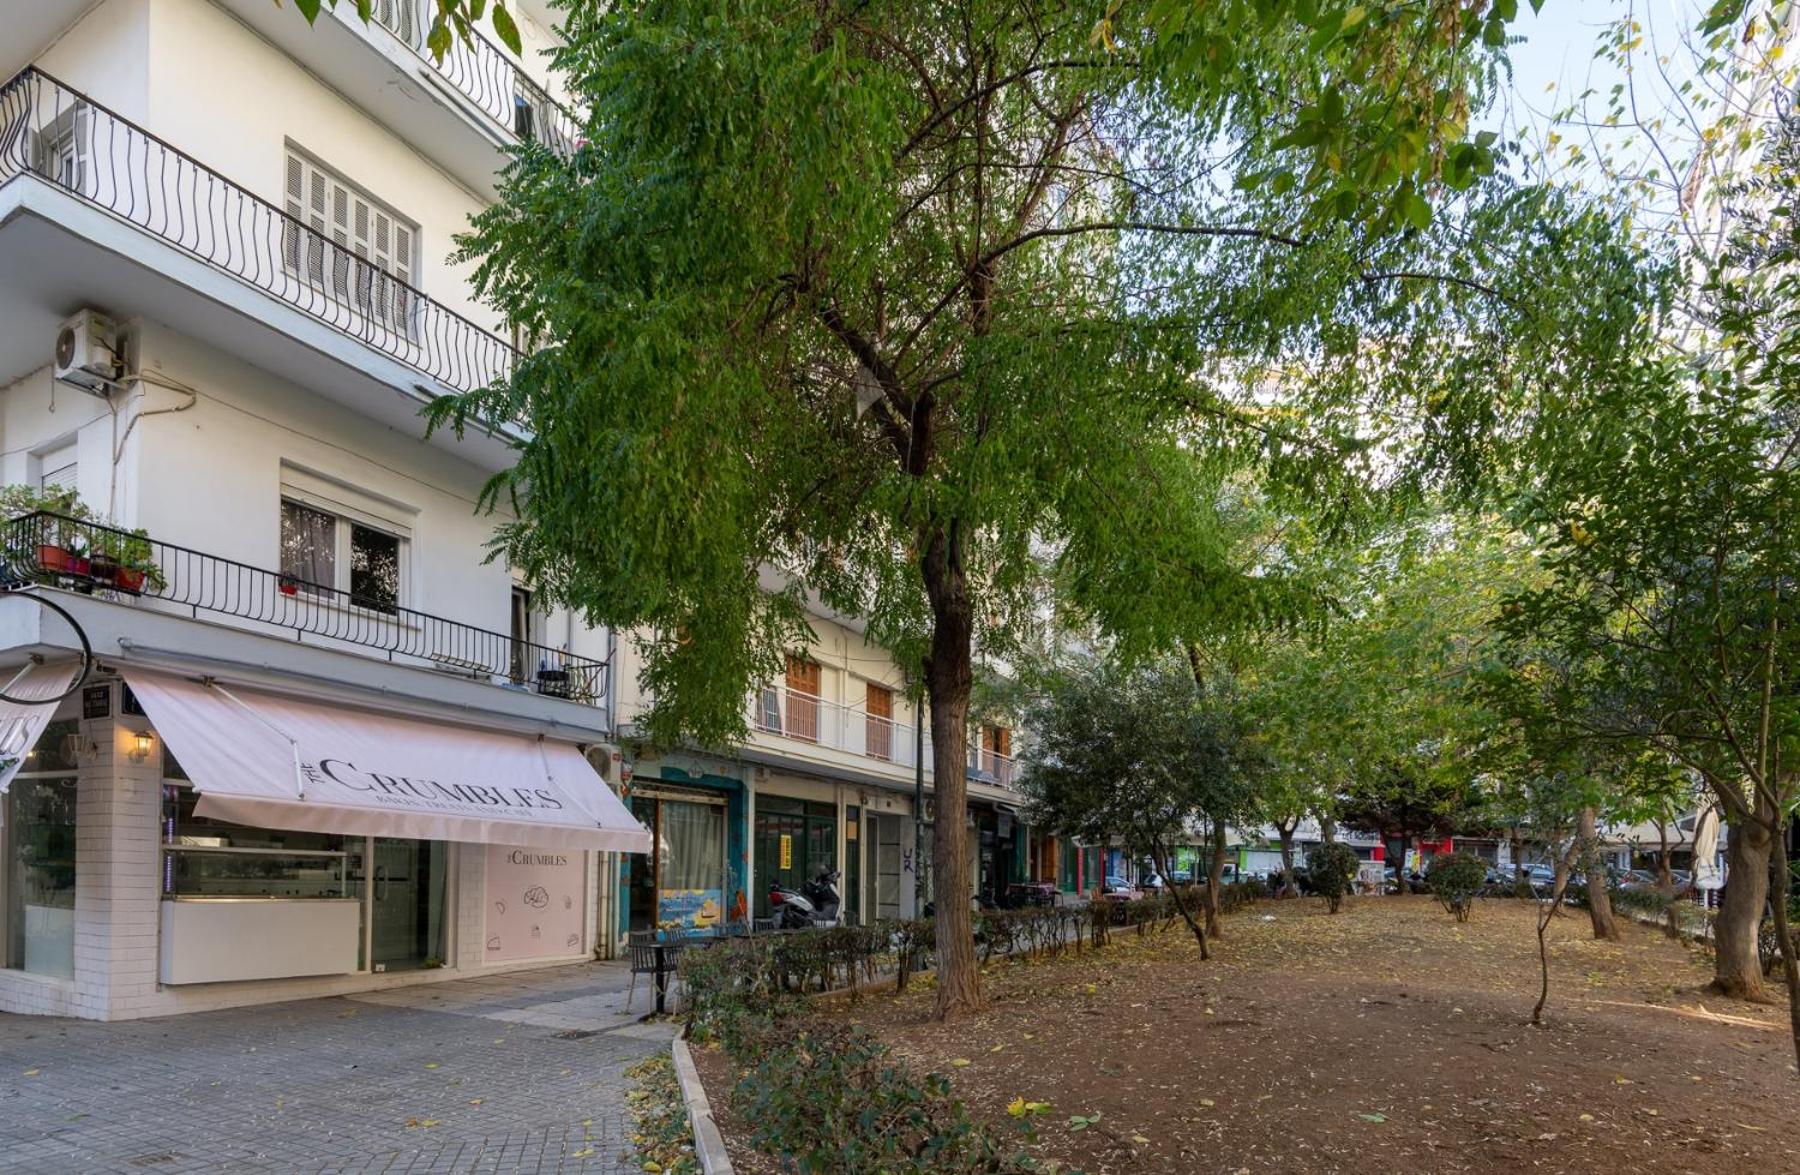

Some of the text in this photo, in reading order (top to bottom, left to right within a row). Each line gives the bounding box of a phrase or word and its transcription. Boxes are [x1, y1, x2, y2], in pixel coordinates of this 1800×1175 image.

[300, 762, 325, 784] THE
[319, 758, 562, 810] CRUMBLES
[511, 849, 567, 866] CRUMBLES
